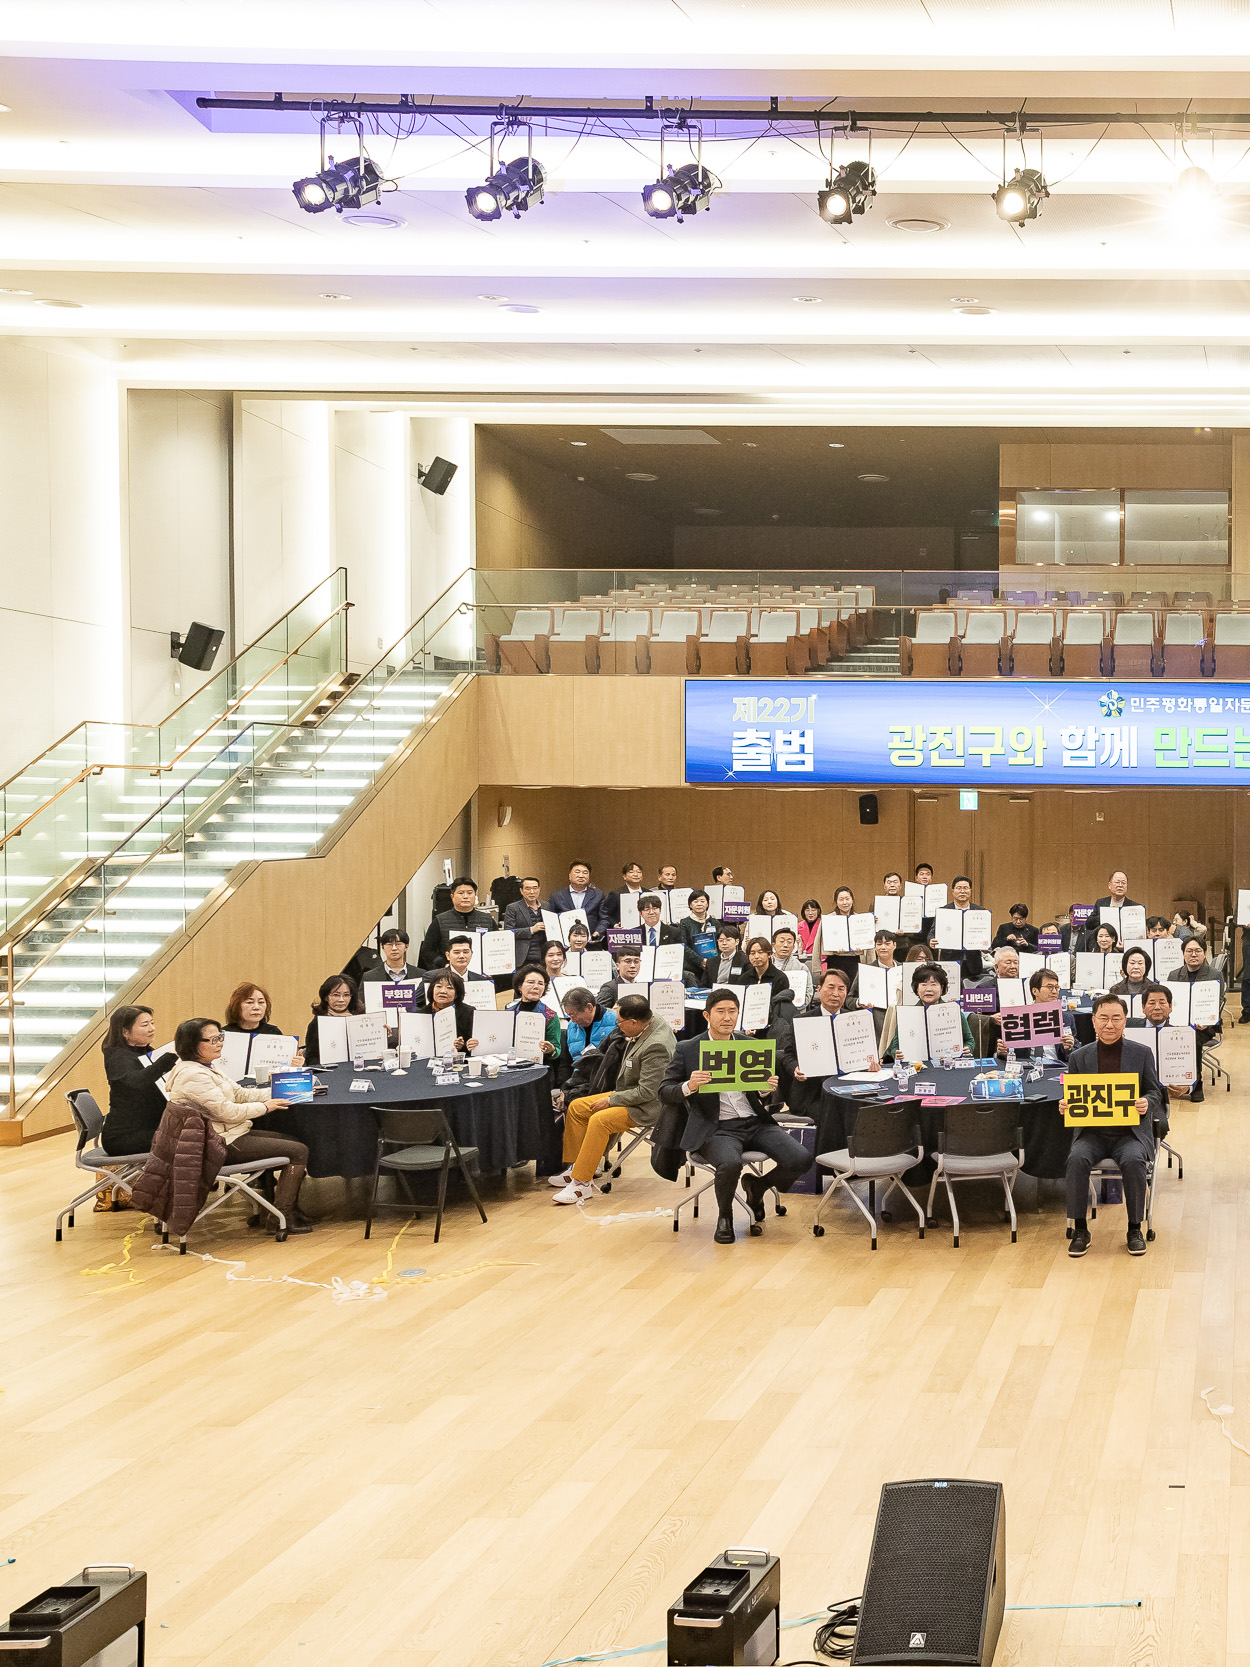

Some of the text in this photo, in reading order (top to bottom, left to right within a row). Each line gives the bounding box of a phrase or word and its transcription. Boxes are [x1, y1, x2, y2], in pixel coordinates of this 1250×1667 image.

[732, 696, 816, 723] 제22기
[731, 729, 814, 771] 출범
[888, 725, 1047, 768] 광진구와
[1060, 726, 1138, 768] 함께
[725, 906, 750, 914] 자문위원
[609, 934, 642, 943] 자문위원
[385, 990, 413, 998] 부회장
[966, 994, 992, 1002] 내빈석
[1002, 1011, 1062, 1045] 협력
[702, 1049, 774, 1084] 번영
[1067, 1083, 1137, 1118] 광진구
